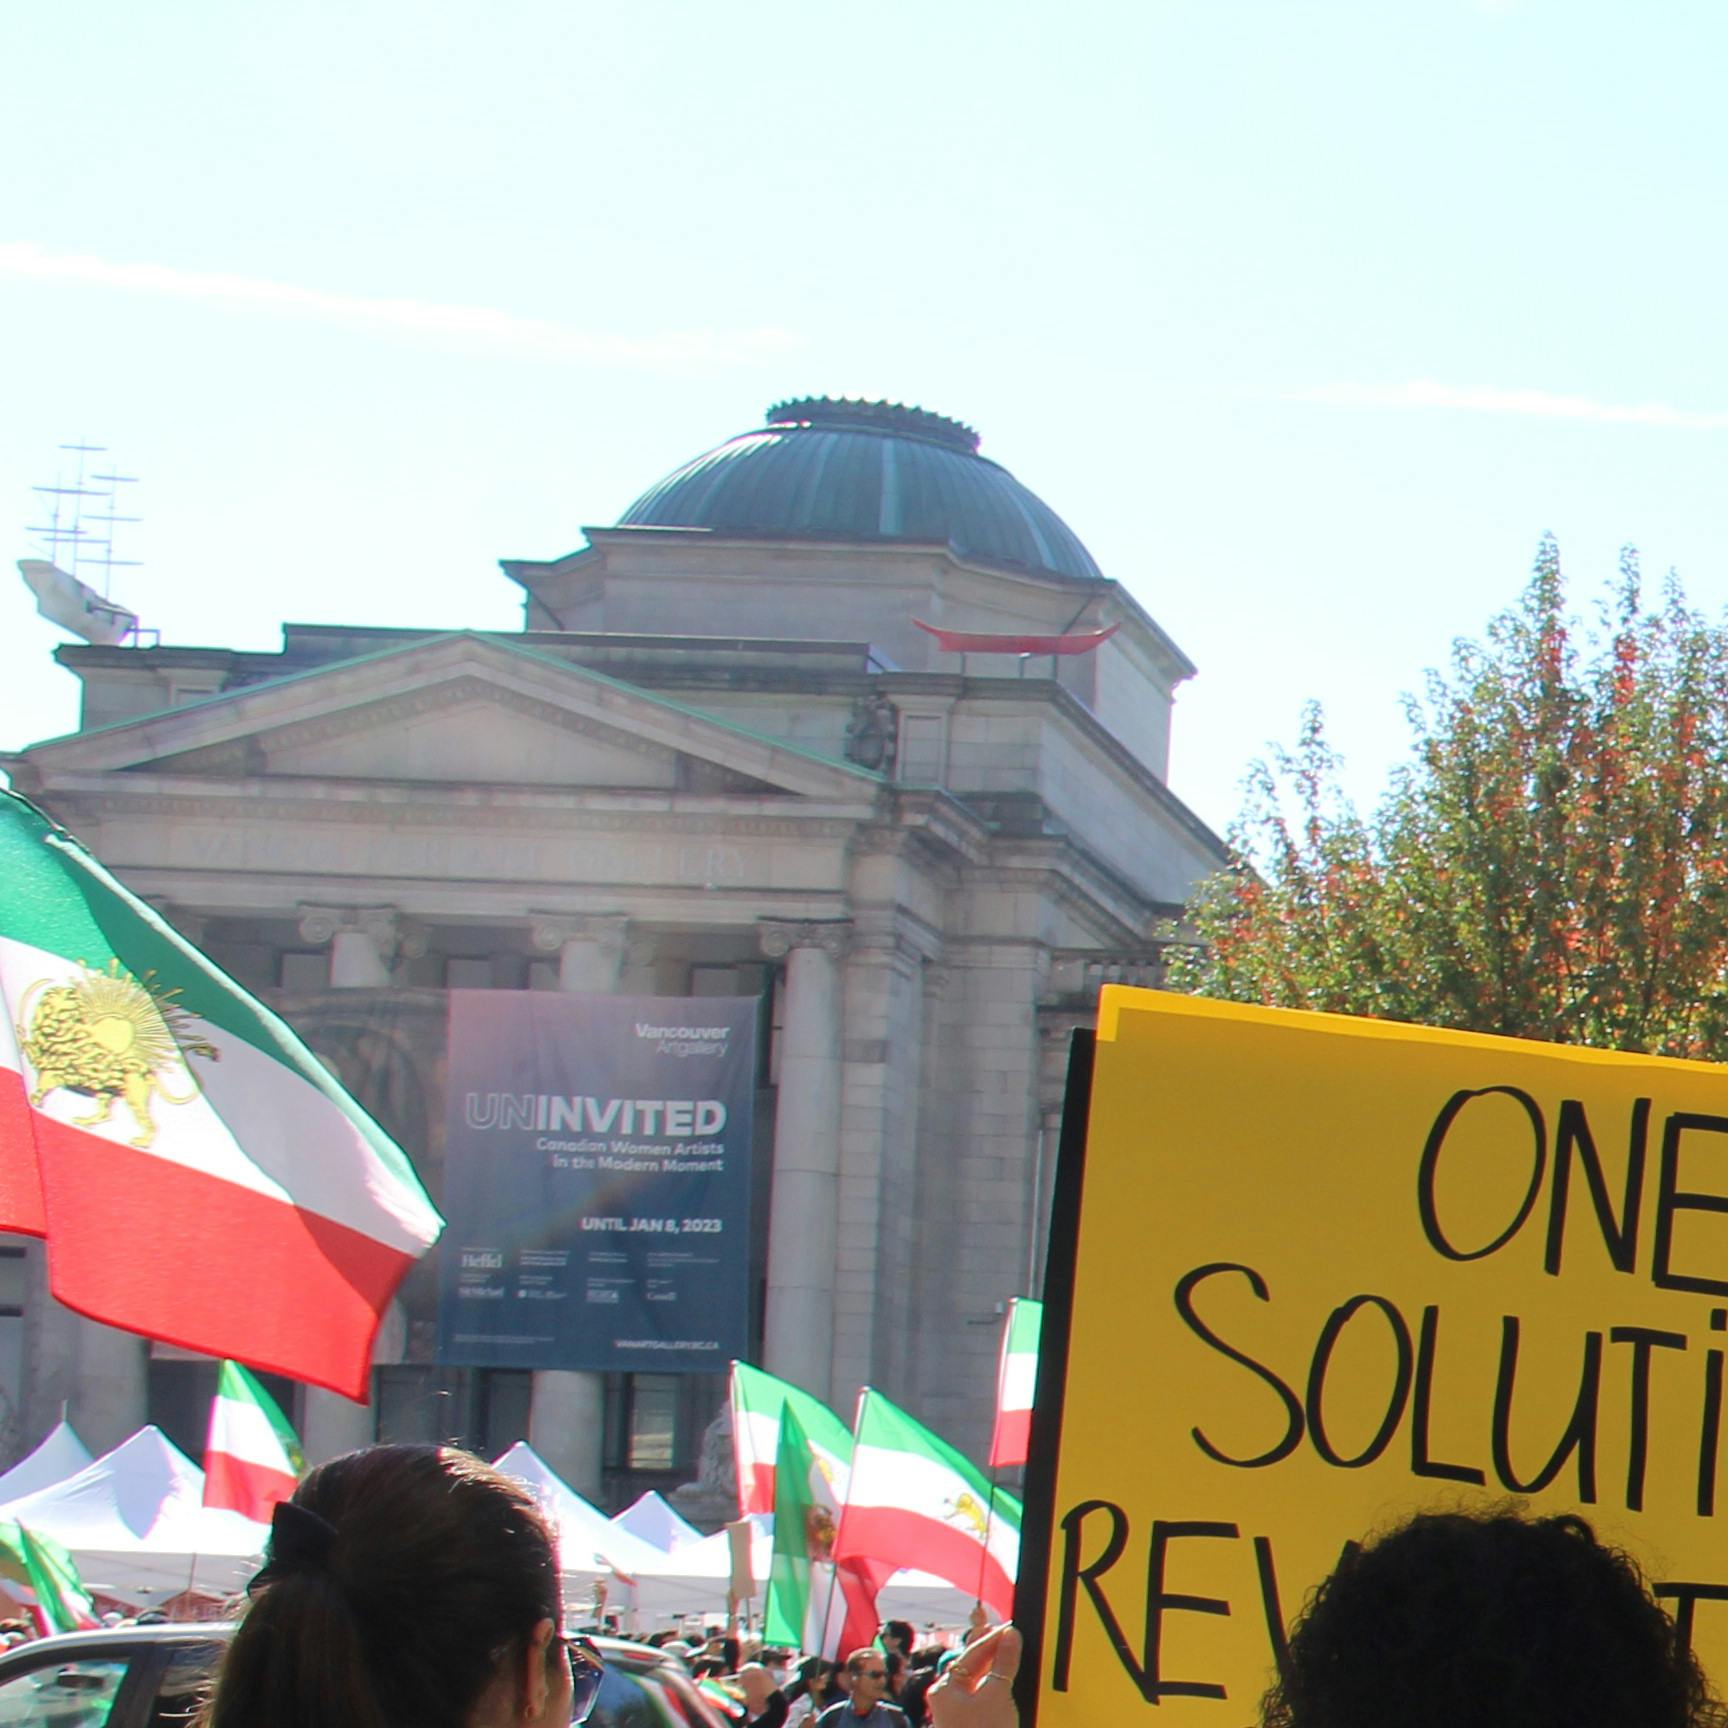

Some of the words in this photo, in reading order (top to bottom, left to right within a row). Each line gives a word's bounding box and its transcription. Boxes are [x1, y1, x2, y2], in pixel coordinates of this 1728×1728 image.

[635, 1023, 730, 1040] Vancouver
[466, 1092, 728, 1137] UNINVITED
[537, 1137, 606, 1153] Canadian
[611, 1140, 671, 1155] Women
[675, 1142, 724, 1156] Artists
[553, 1154, 568, 1168] in
[572, 1155, 594, 1169] the
[598, 1156, 660, 1172] Modern
[662, 1159, 724, 1172] Moment
[581, 1217, 627, 1232] UNTIL
[629, 1218, 663, 1232] JAN
[665, 1219, 680, 1234] 8,
[683, 1219, 722, 1233] 2023
